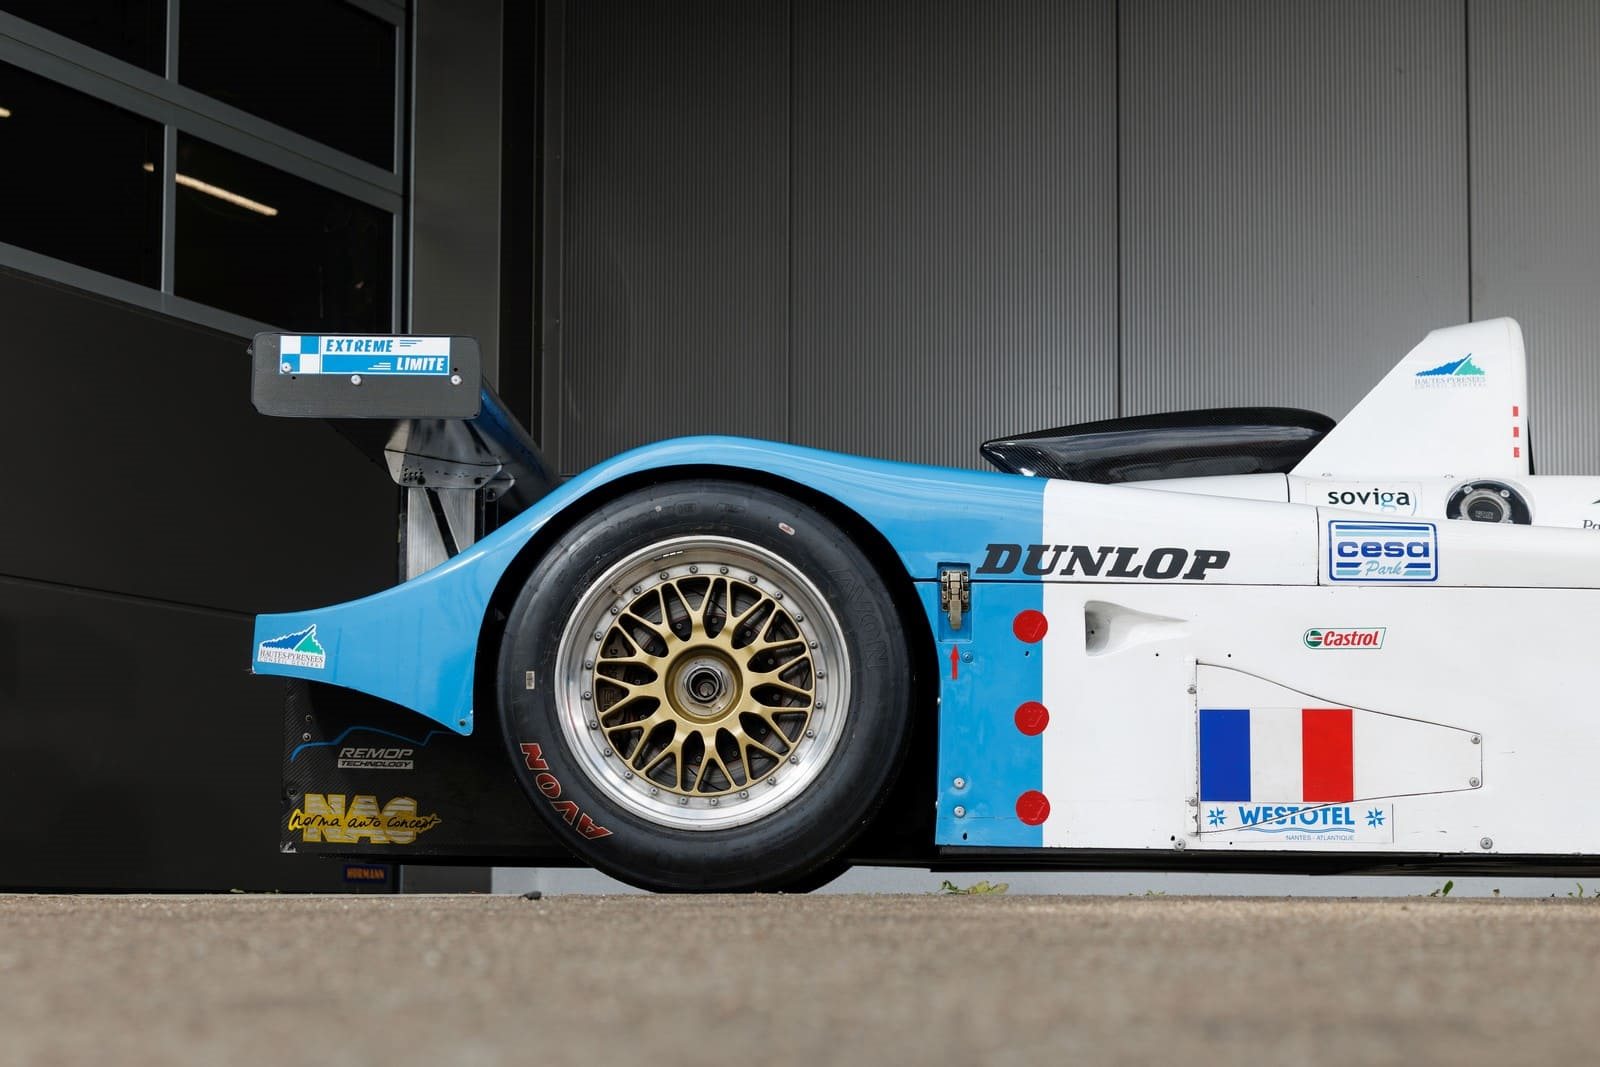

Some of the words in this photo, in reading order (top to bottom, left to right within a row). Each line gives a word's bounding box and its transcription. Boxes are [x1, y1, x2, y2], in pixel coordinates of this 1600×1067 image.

[326, 339, 393, 353] EXTREME
[396, 357, 445, 371] LIMITE
[1327, 487, 1411, 512] soviga
[1337, 541, 1430, 558] cesa
[975, 543, 1231, 580] DUNLOP
[1364, 560, 1404, 576] Park
[1324, 630, 1379, 647] Castrol
[339, 747, 414, 759] REMOP
[341, 760, 411, 768] TECHNOLOGY
[520, 743, 614, 840] AVON
[1238, 806, 1355, 825] WESTOTEL
